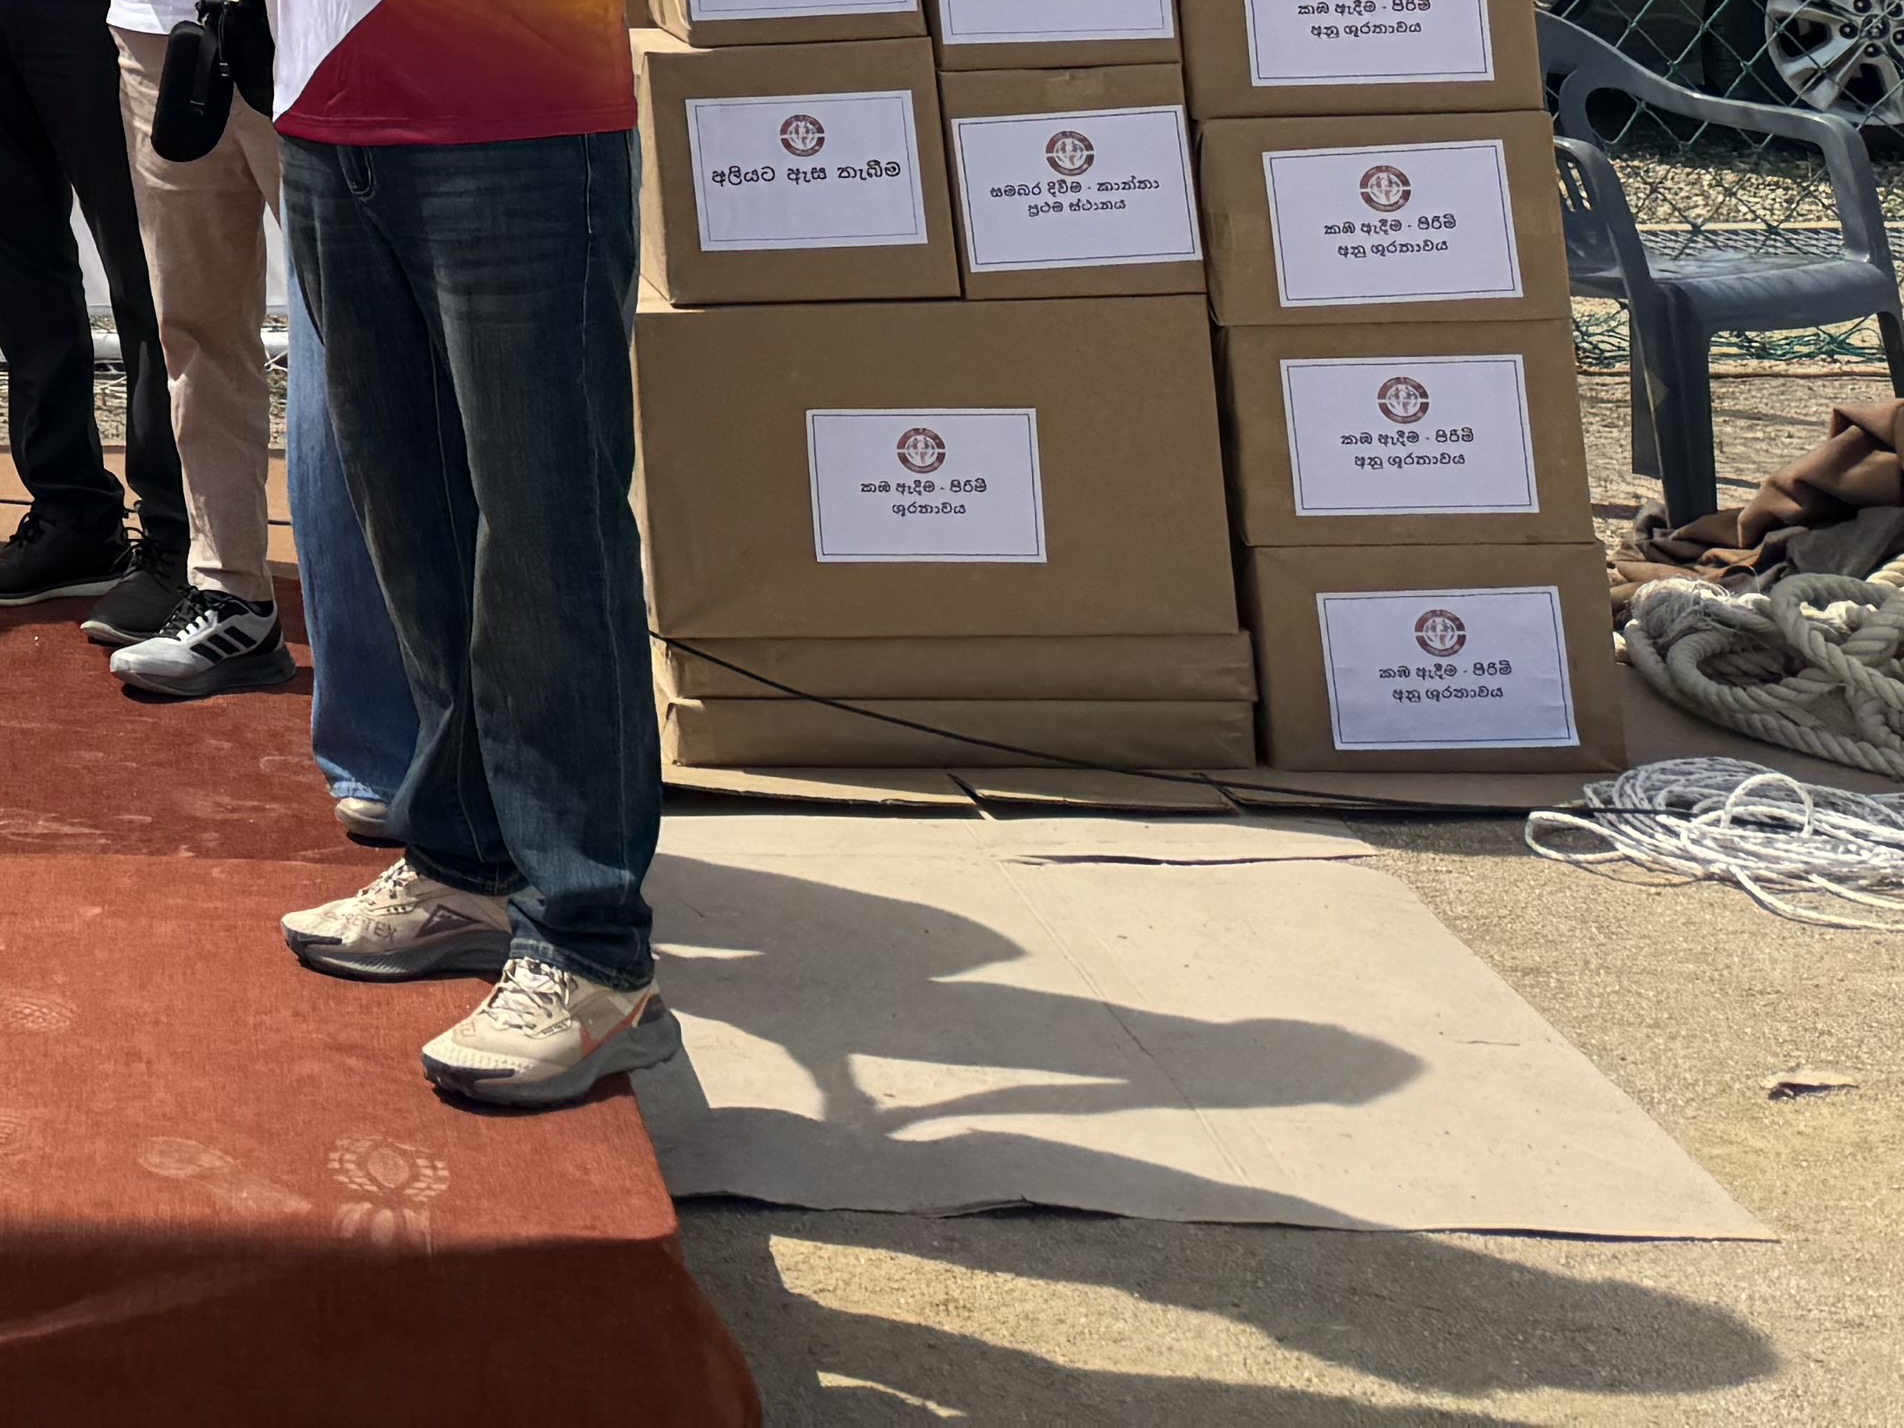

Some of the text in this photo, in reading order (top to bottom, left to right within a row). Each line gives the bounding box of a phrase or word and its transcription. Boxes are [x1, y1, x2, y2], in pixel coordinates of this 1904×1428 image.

[711, 159, 901, 188] අලියට ඇස තැබීම
